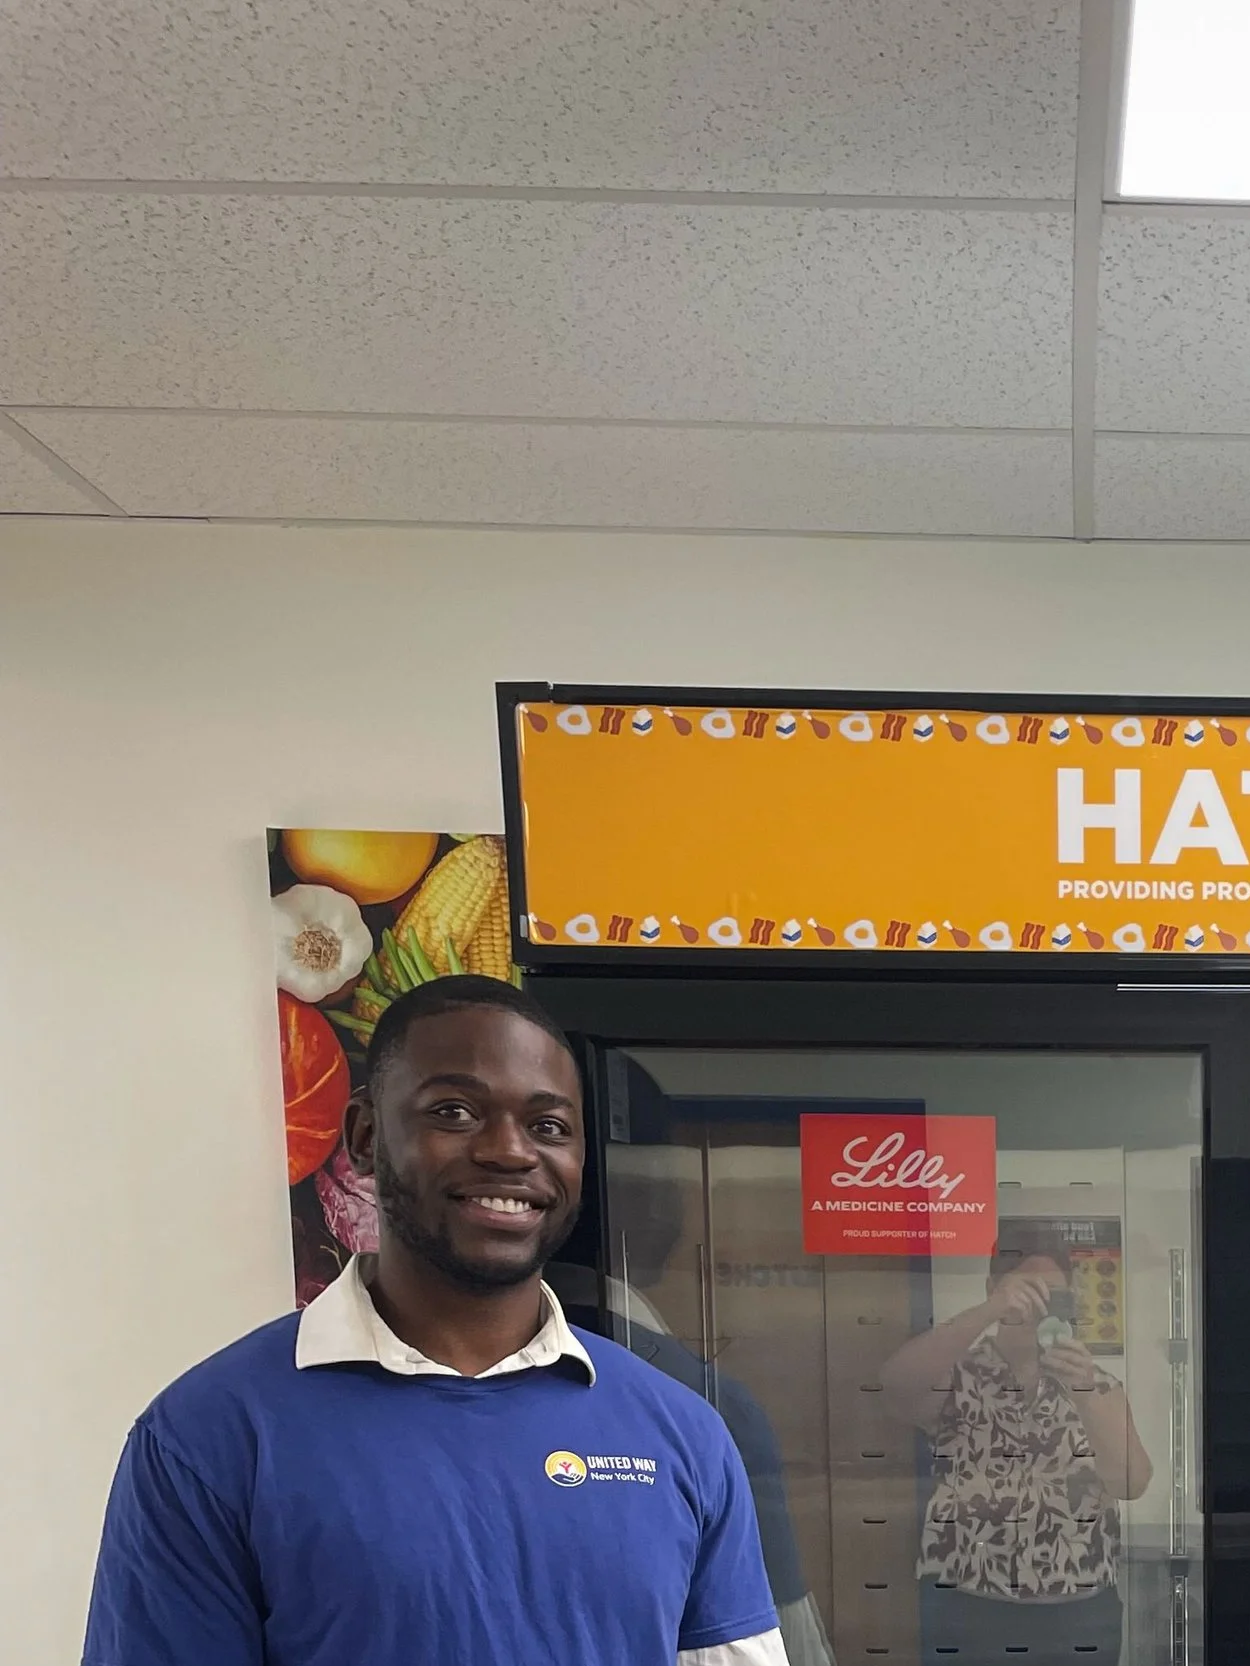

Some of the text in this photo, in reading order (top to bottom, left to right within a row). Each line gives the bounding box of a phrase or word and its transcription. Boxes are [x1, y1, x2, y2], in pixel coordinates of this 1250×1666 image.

[1058, 880, 1195, 901] PROVIDING
[831, 1132, 966, 1200] Lilly
[811, 1200, 986, 1213] A MEDICINE COMPANY
[843, 1229, 957, 1240] PROUD SUPPORTER OF HATCH
[587, 1455, 657, 1472] UNITED WAY
[590, 1472, 655, 1486] New York City
